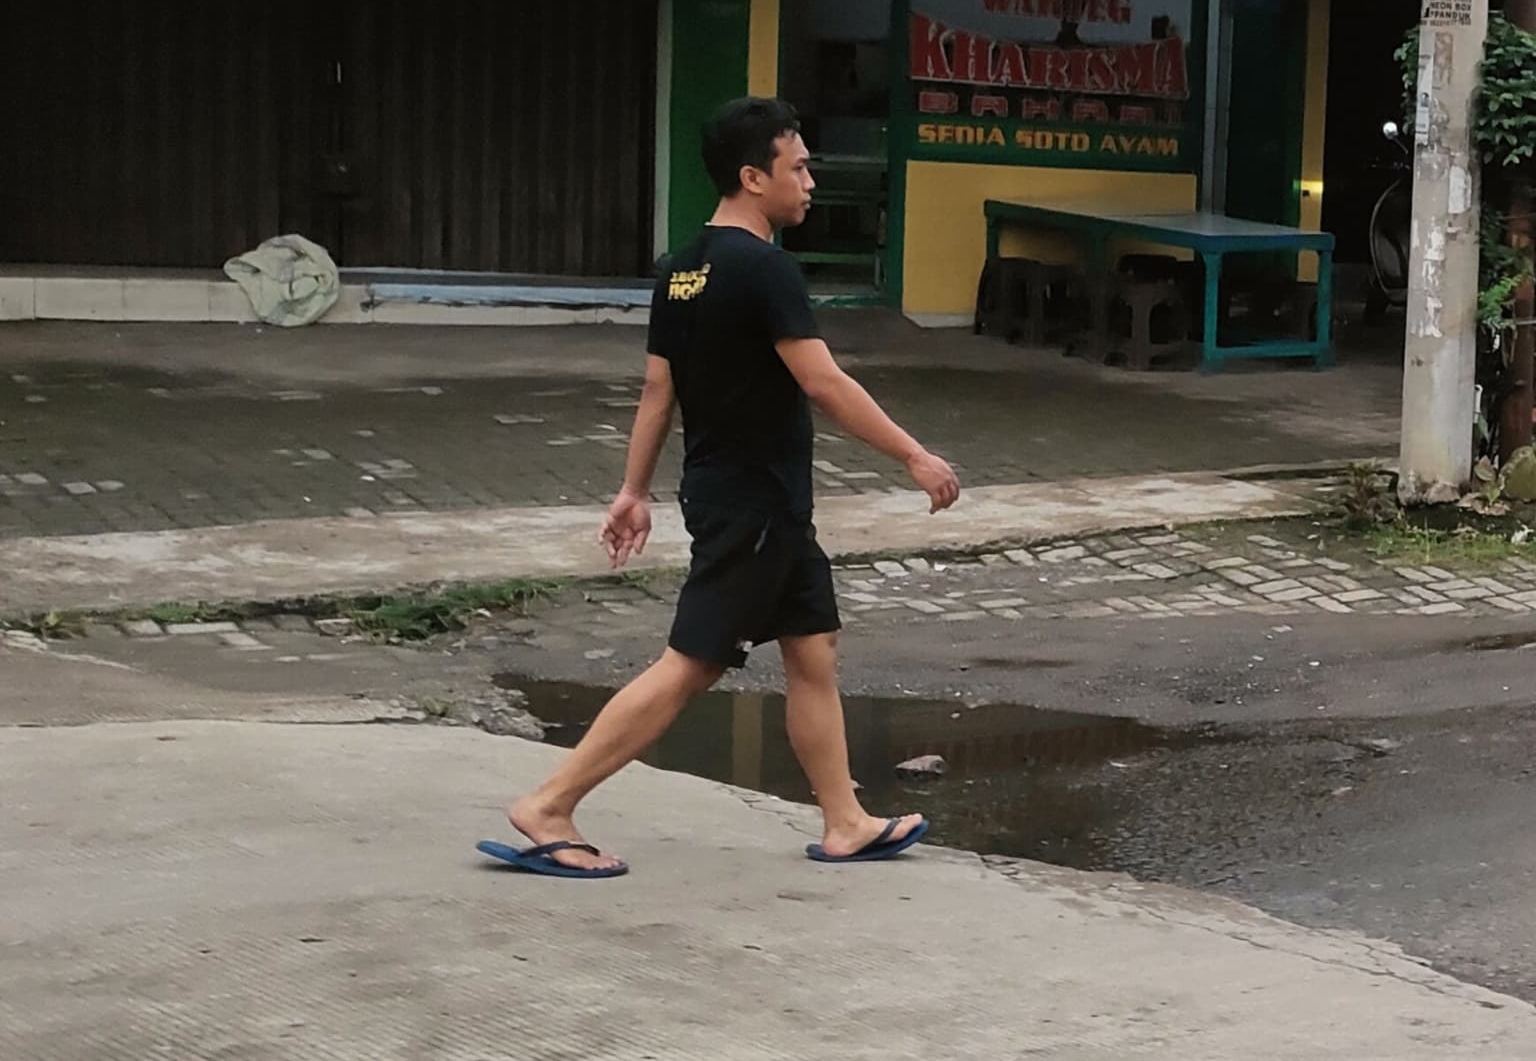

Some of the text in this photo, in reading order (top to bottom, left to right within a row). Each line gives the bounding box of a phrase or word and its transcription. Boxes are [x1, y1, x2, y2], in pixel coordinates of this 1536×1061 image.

[910, 10, 1189, 100] KHARISMA
[917, 123, 1180, 157] SEDIA SOTO AYAM
